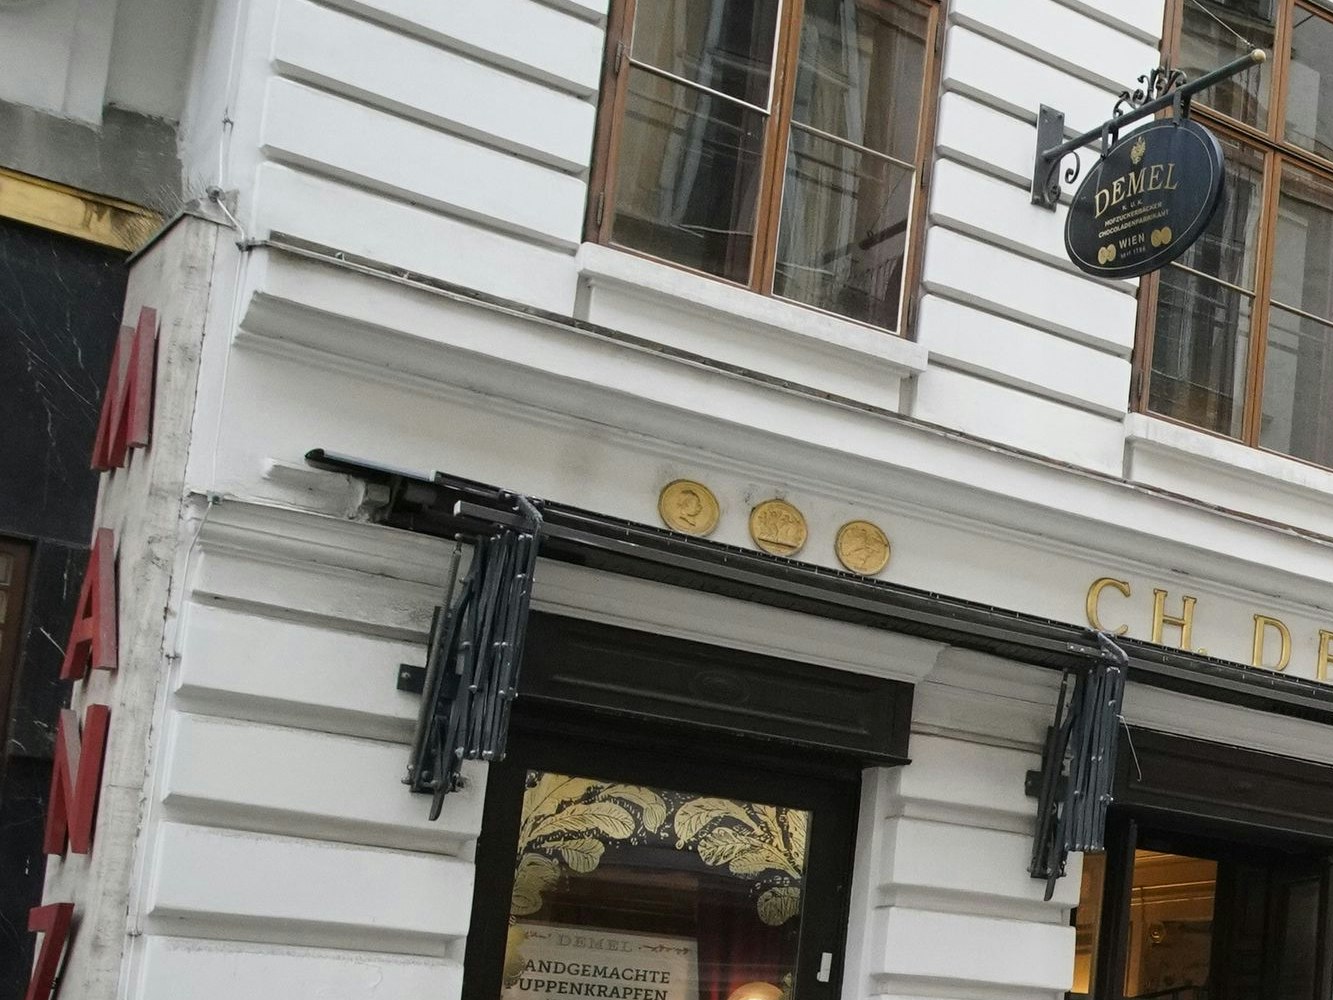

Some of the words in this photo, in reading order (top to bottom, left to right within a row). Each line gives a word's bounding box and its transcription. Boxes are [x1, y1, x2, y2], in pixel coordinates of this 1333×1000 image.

[1095, 163, 1179, 218] DEMEL
[1119, 233, 1145, 249] WIEN
[557, 933, 634, 953] DEMEL
[523, 958, 671, 984] ANDGEMACHTE
